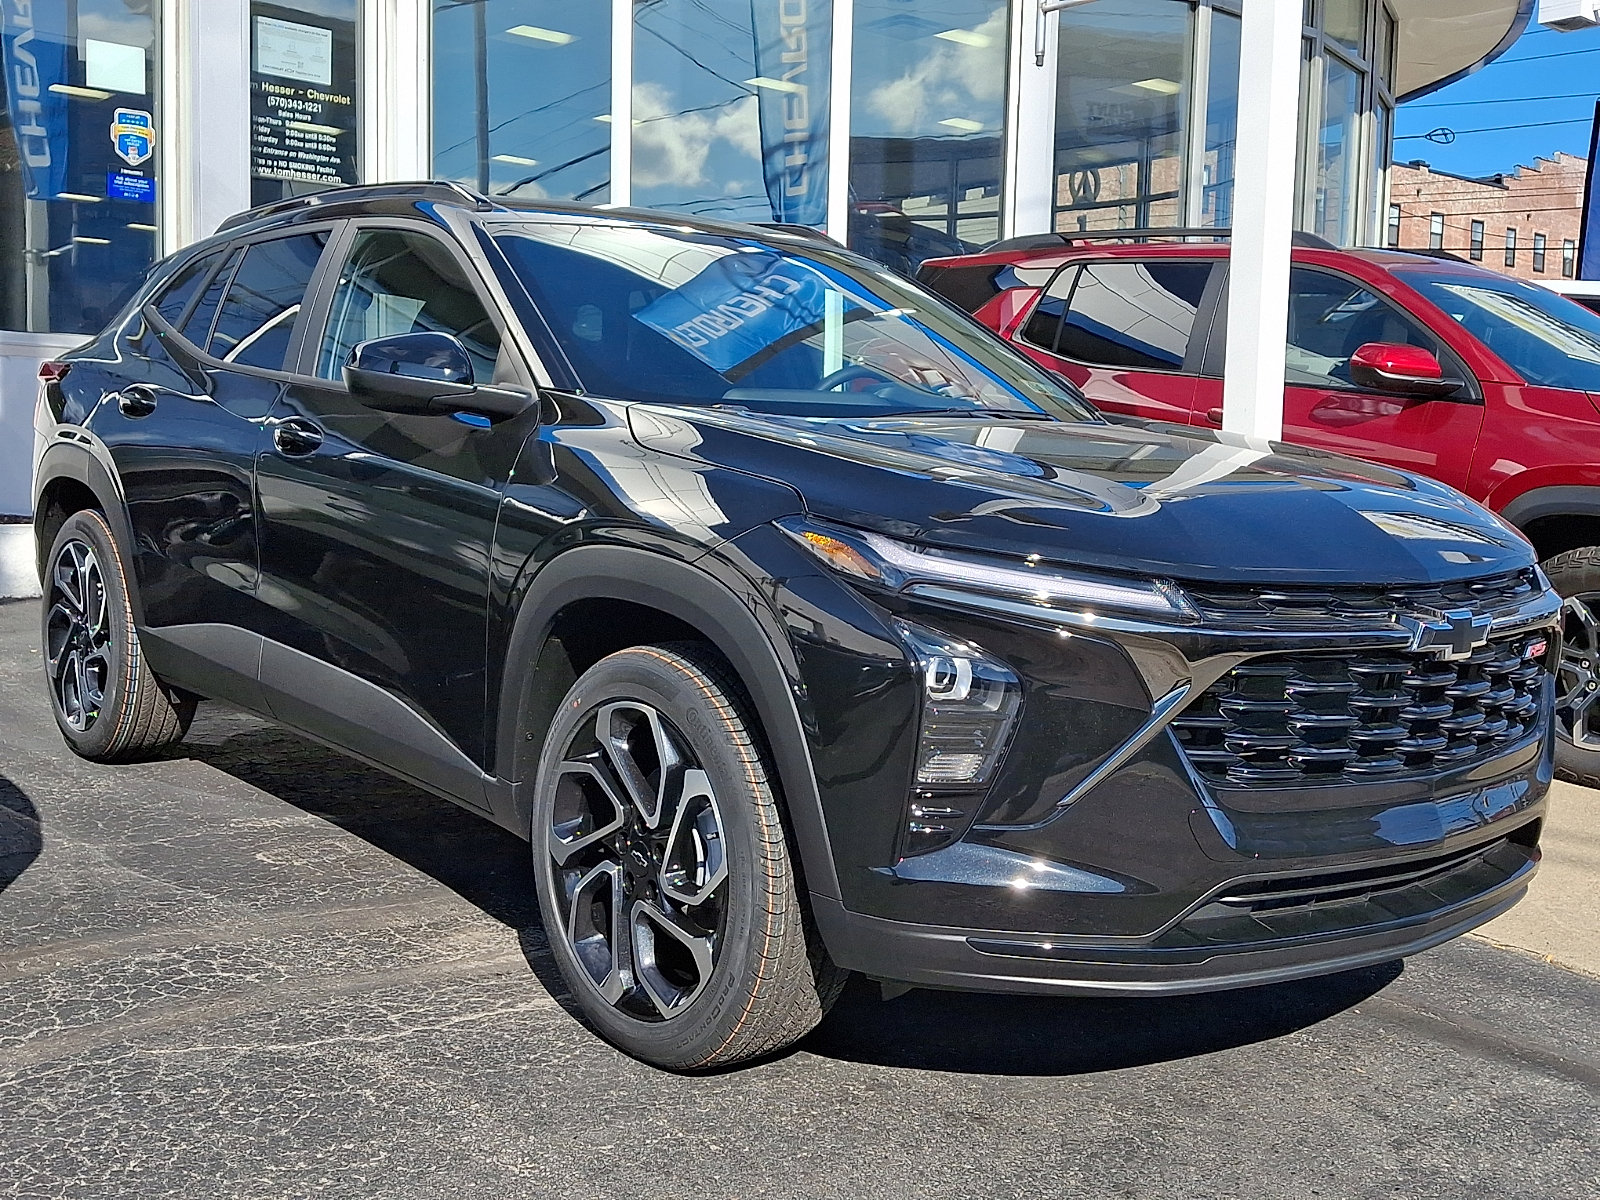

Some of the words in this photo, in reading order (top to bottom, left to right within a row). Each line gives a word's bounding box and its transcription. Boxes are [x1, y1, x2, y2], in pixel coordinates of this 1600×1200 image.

[262, 82, 296, 96] Hesser
[306, 88, 351, 105] Chevrolet
[267, 96, 322, 113] (570)343-1221
[278, 110, 294, 119] Sales
[294, 112, 312, 121] Hours
[252, 125, 271, 135] Friday
[253, 134, 279, 145] Saturday
[262, 146, 288, 156] Entrance
[298, 151, 329, 163] Washington
[278, 160, 288, 168] NO
